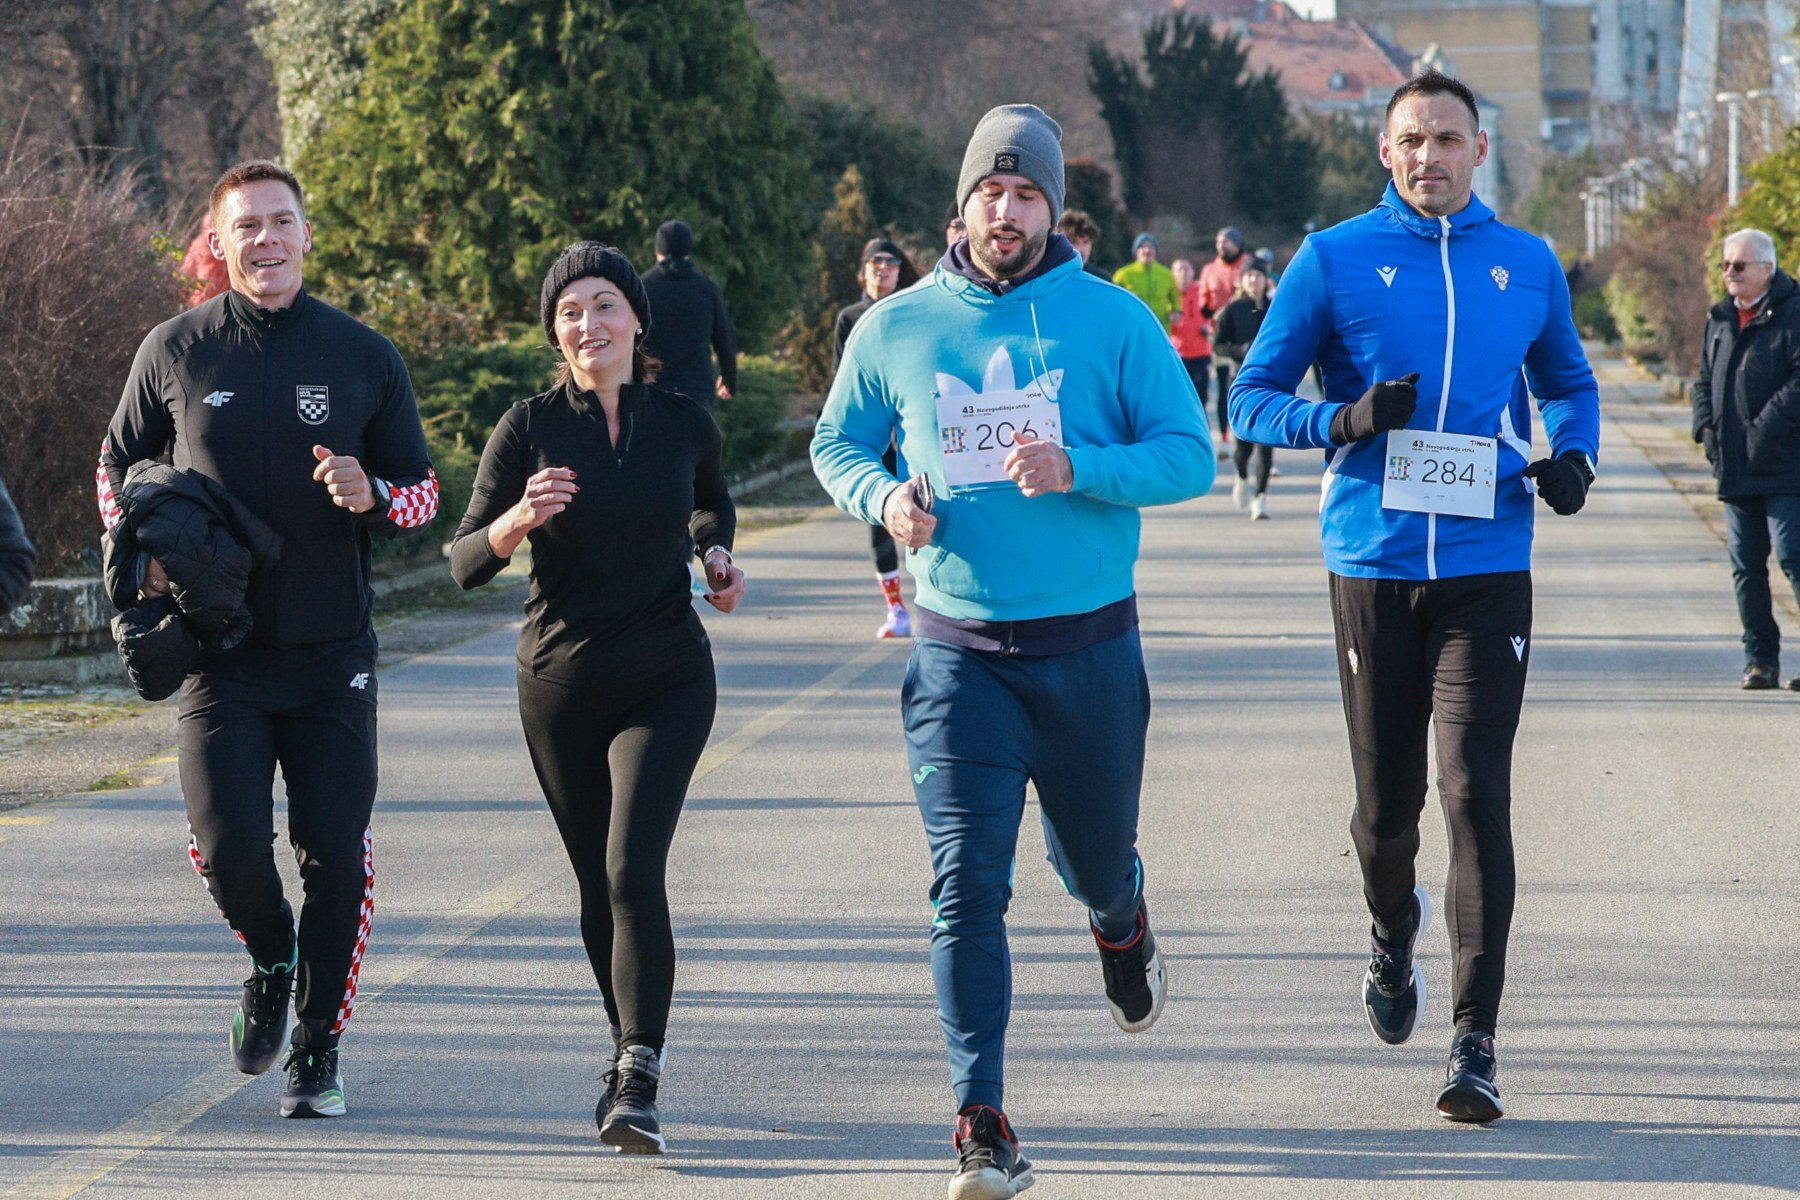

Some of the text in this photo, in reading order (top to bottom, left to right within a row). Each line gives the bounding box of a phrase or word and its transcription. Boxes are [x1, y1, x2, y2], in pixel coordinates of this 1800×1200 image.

[202, 390, 235, 407] 4F
[1421, 459, 1476, 487] 284
[350, 672, 369, 690] 4F
